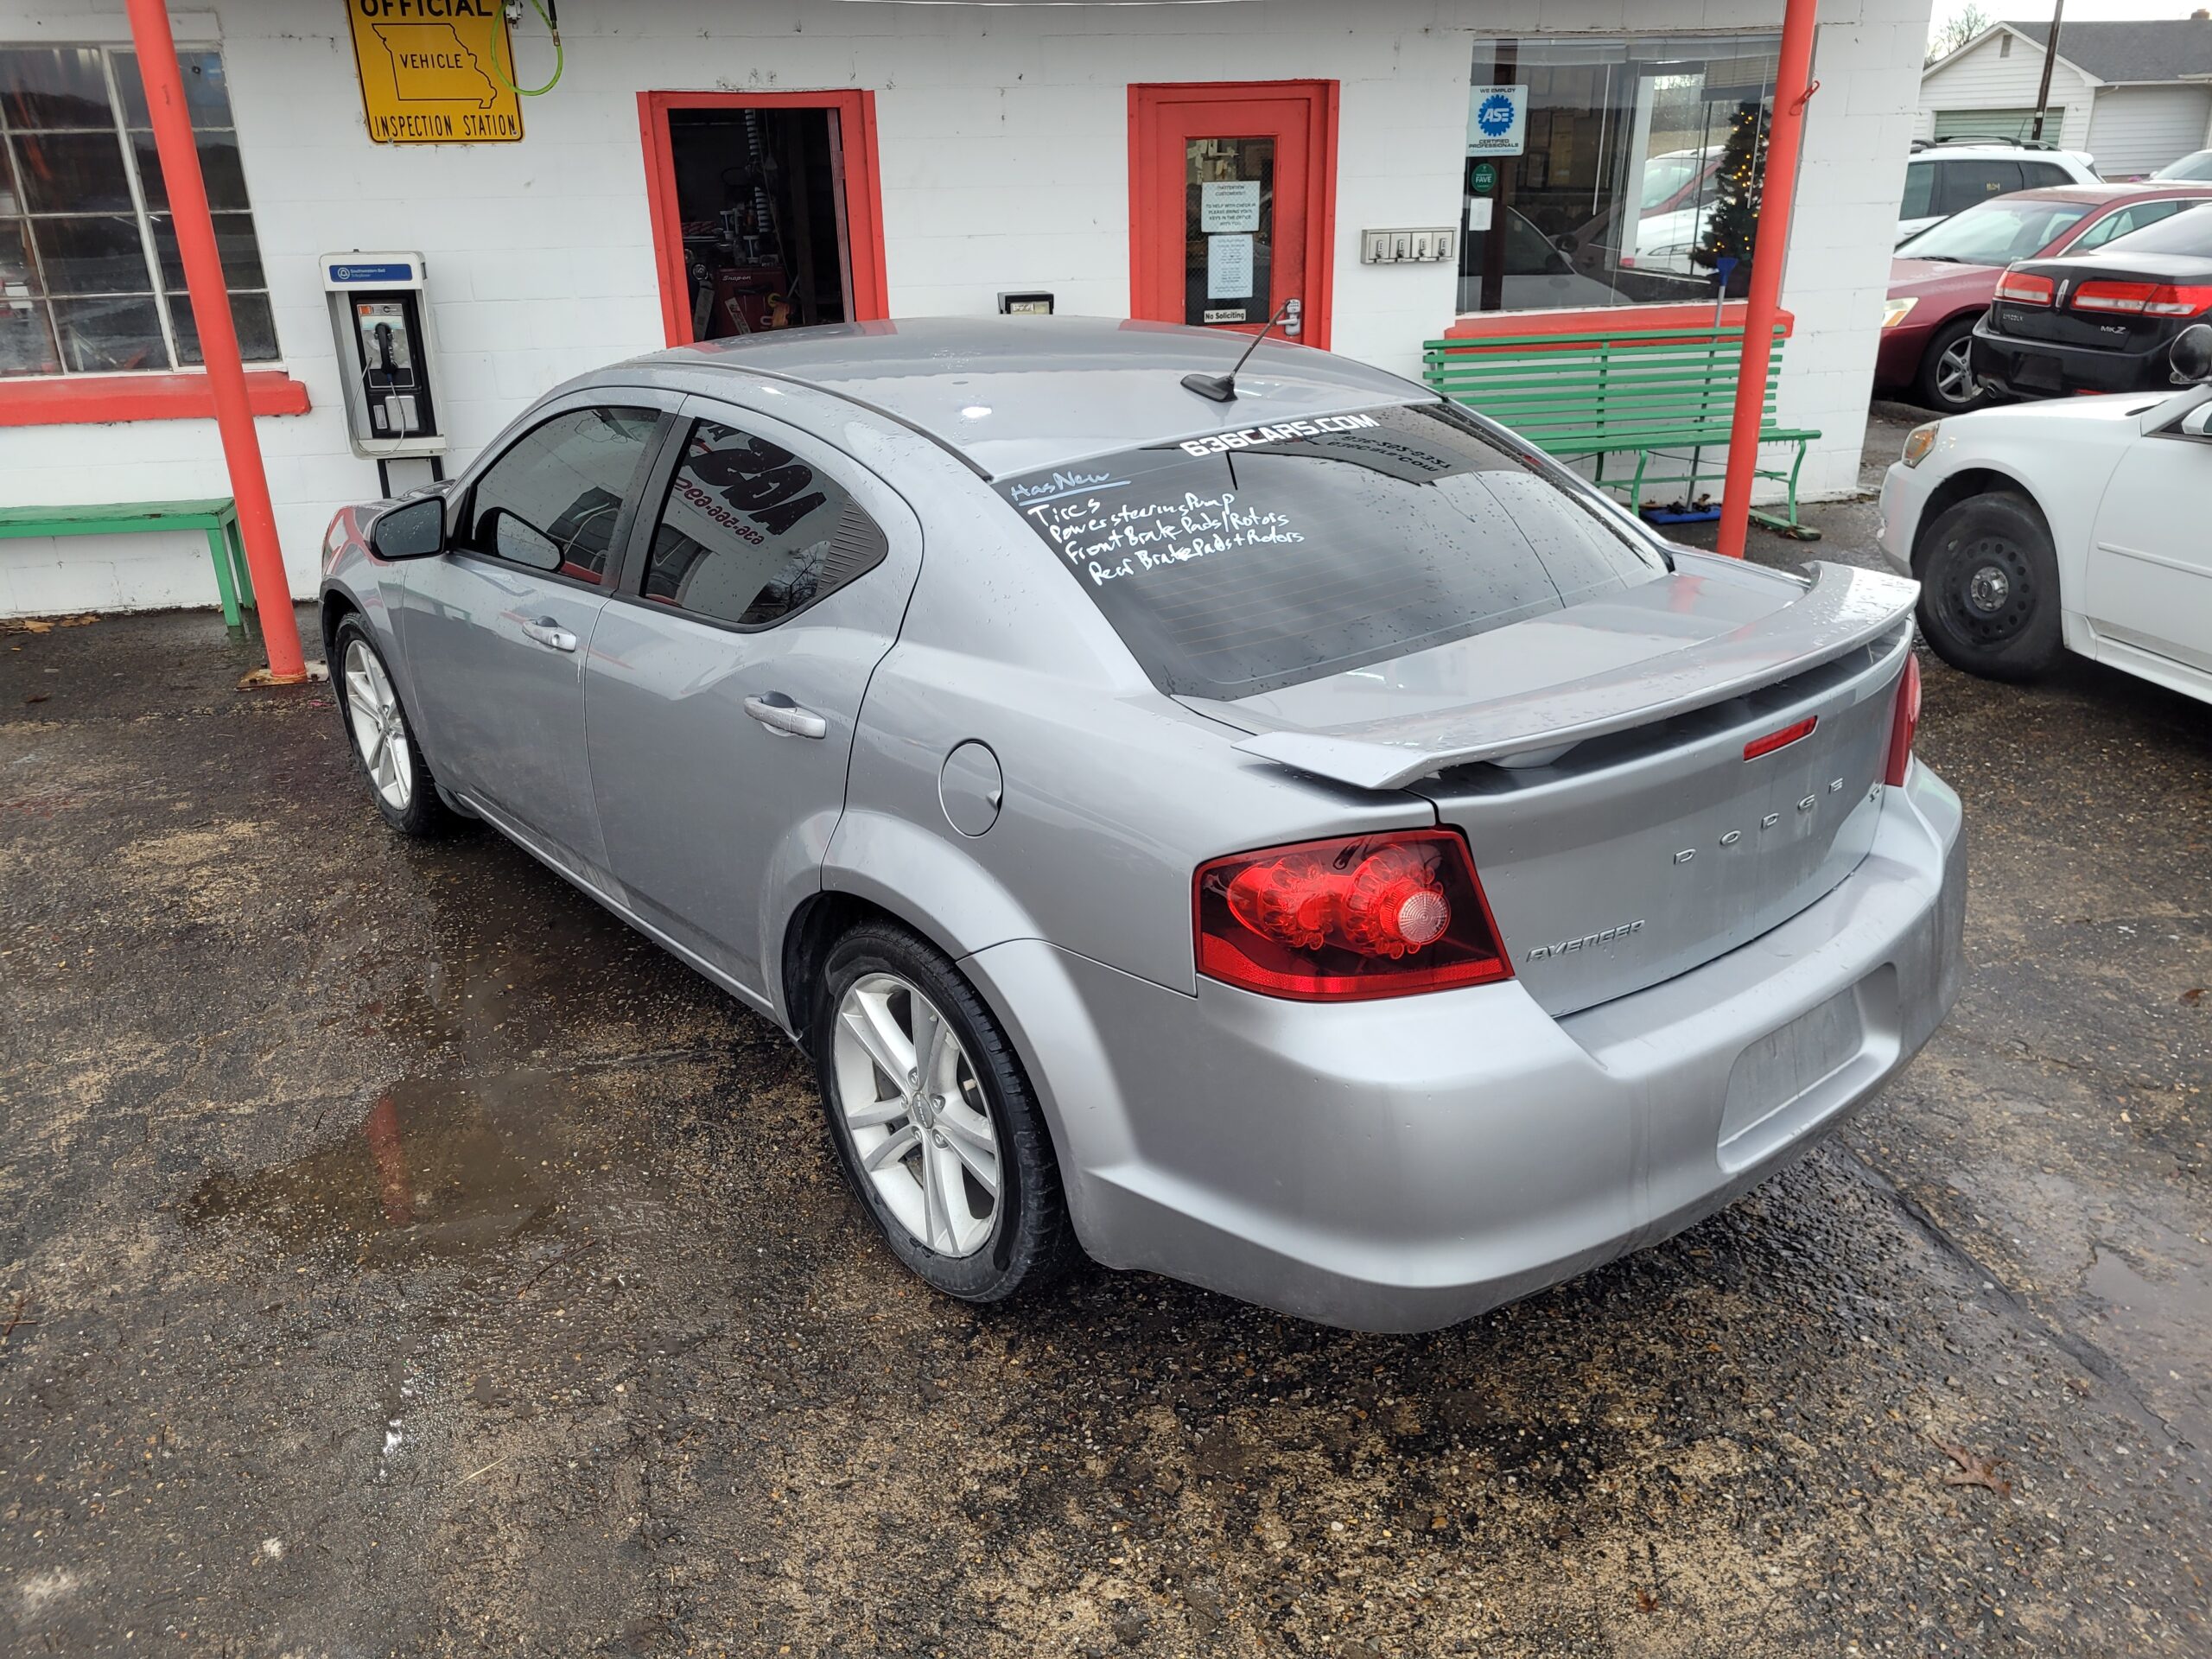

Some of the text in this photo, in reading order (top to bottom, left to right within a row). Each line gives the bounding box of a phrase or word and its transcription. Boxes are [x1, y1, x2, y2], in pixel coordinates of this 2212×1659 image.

[399, 54, 464, 69] VEHICLE
[1482, 107, 1510, 123] ASE
[374, 114, 517, 137] INSPECTION STATION
[1205, 311, 1245, 321] No Soliciting
[2100, 325, 2127, 335] MKZ
[1179, 414, 1382, 458] 636CARS.COM
[1673, 777, 1845, 866] DODGE
[1525, 918, 1646, 963] AVENGER
